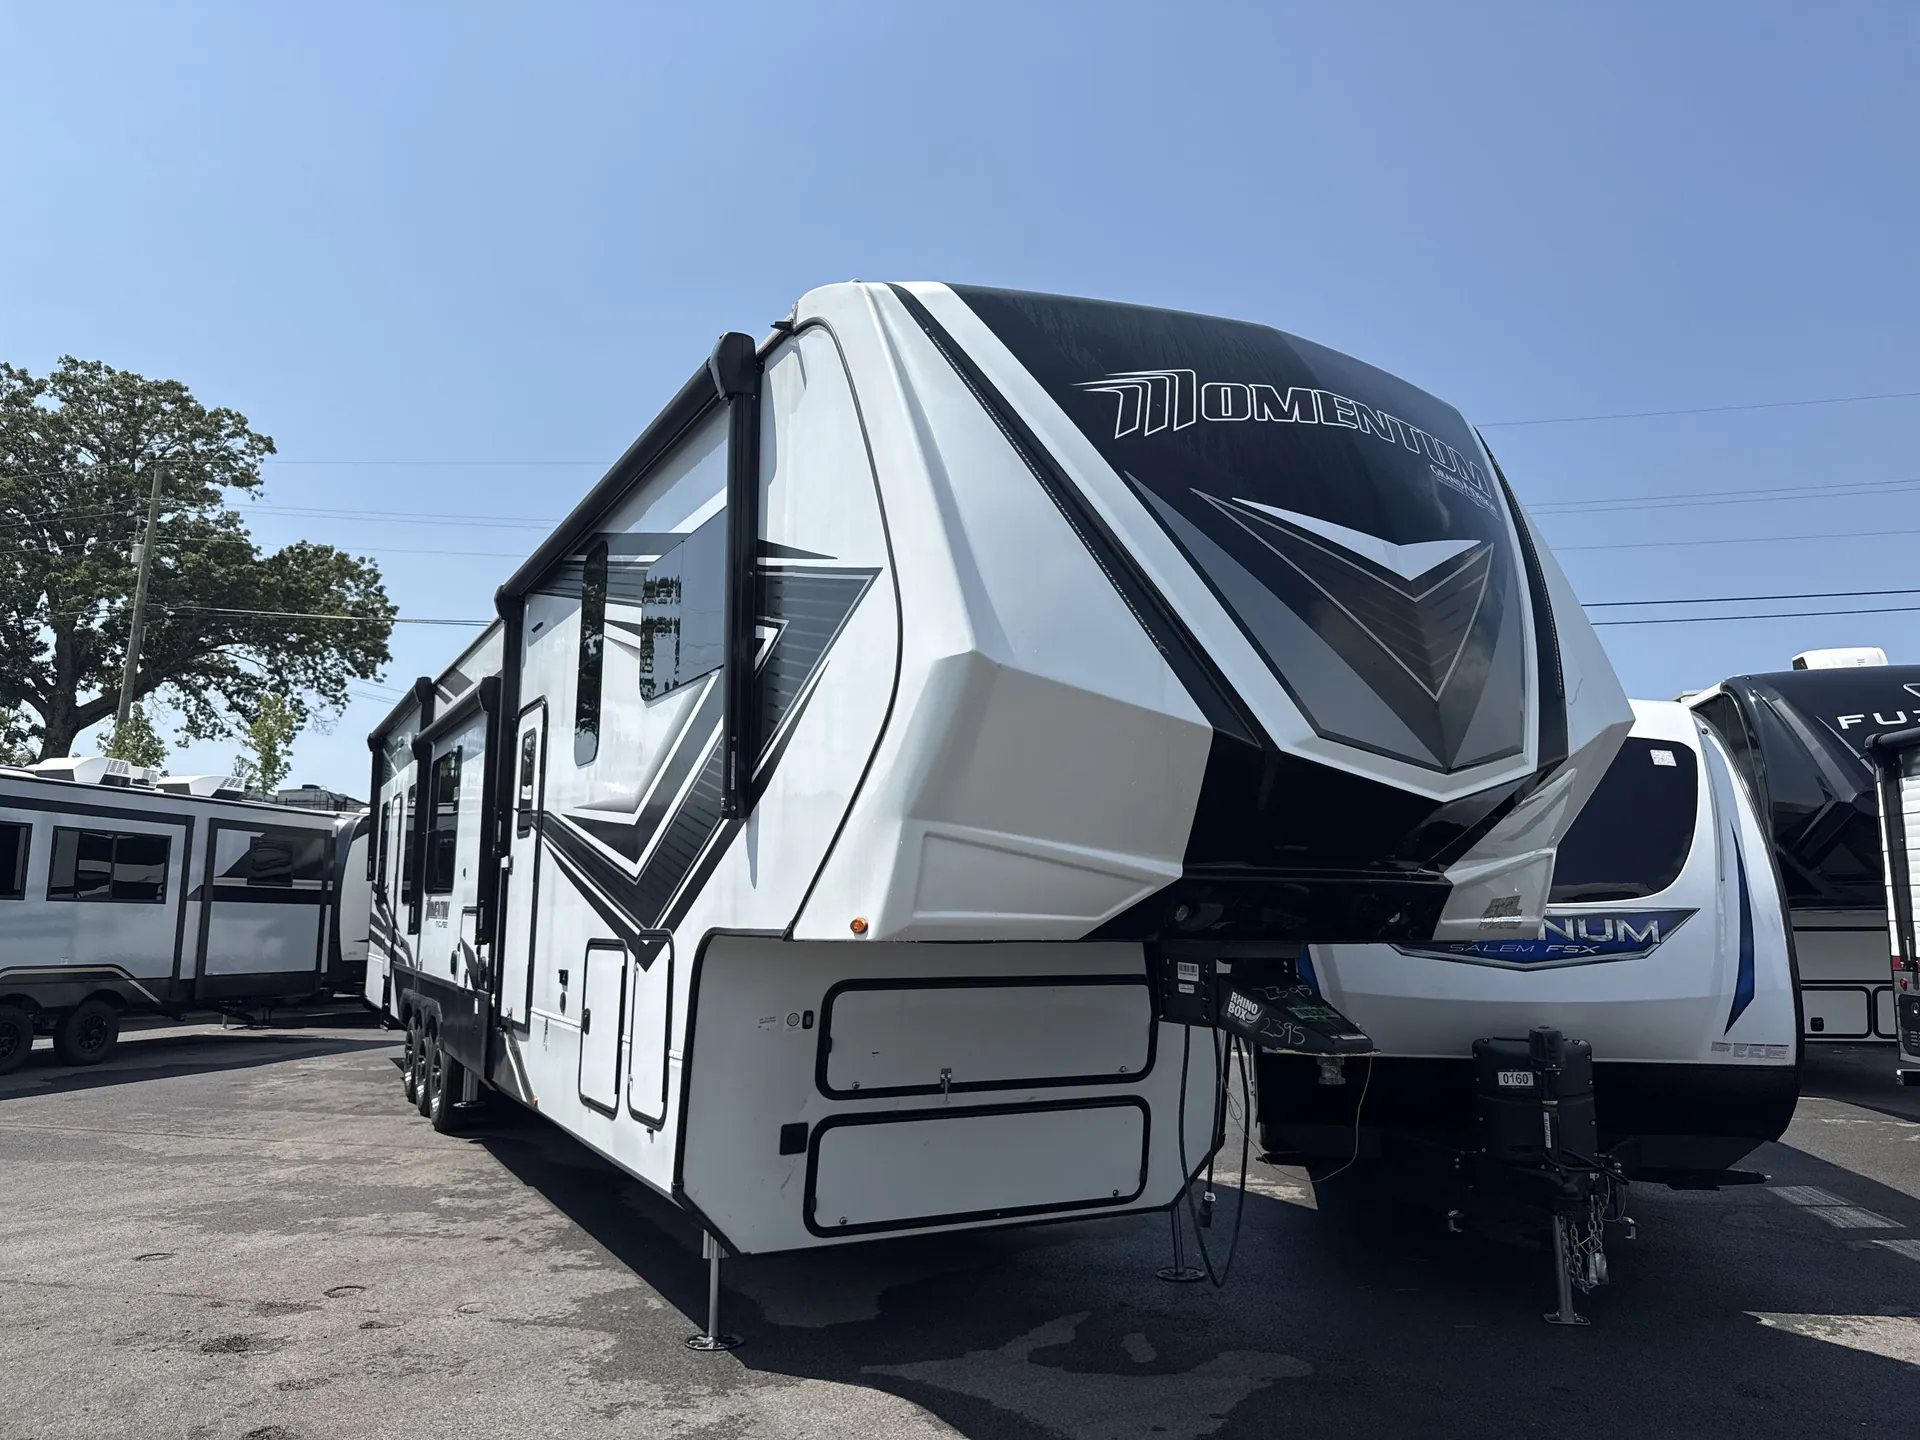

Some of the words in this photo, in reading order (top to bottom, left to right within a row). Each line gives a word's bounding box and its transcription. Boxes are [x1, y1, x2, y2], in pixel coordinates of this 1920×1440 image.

[1071, 368, 1492, 499] MOMENTUM
[1538, 917, 1662, 944] NUM
[1448, 943, 1535, 953] SALEM
[1545, 944, 1601, 954] FSX
[1230, 991, 1259, 1015] RHINO
[1252, 984, 1313, 1001] 2395
[1227, 1001, 1247, 1021] BOX
[1259, 1017, 1306, 1045] 2395
[1502, 1072, 1529, 1085] 0160
